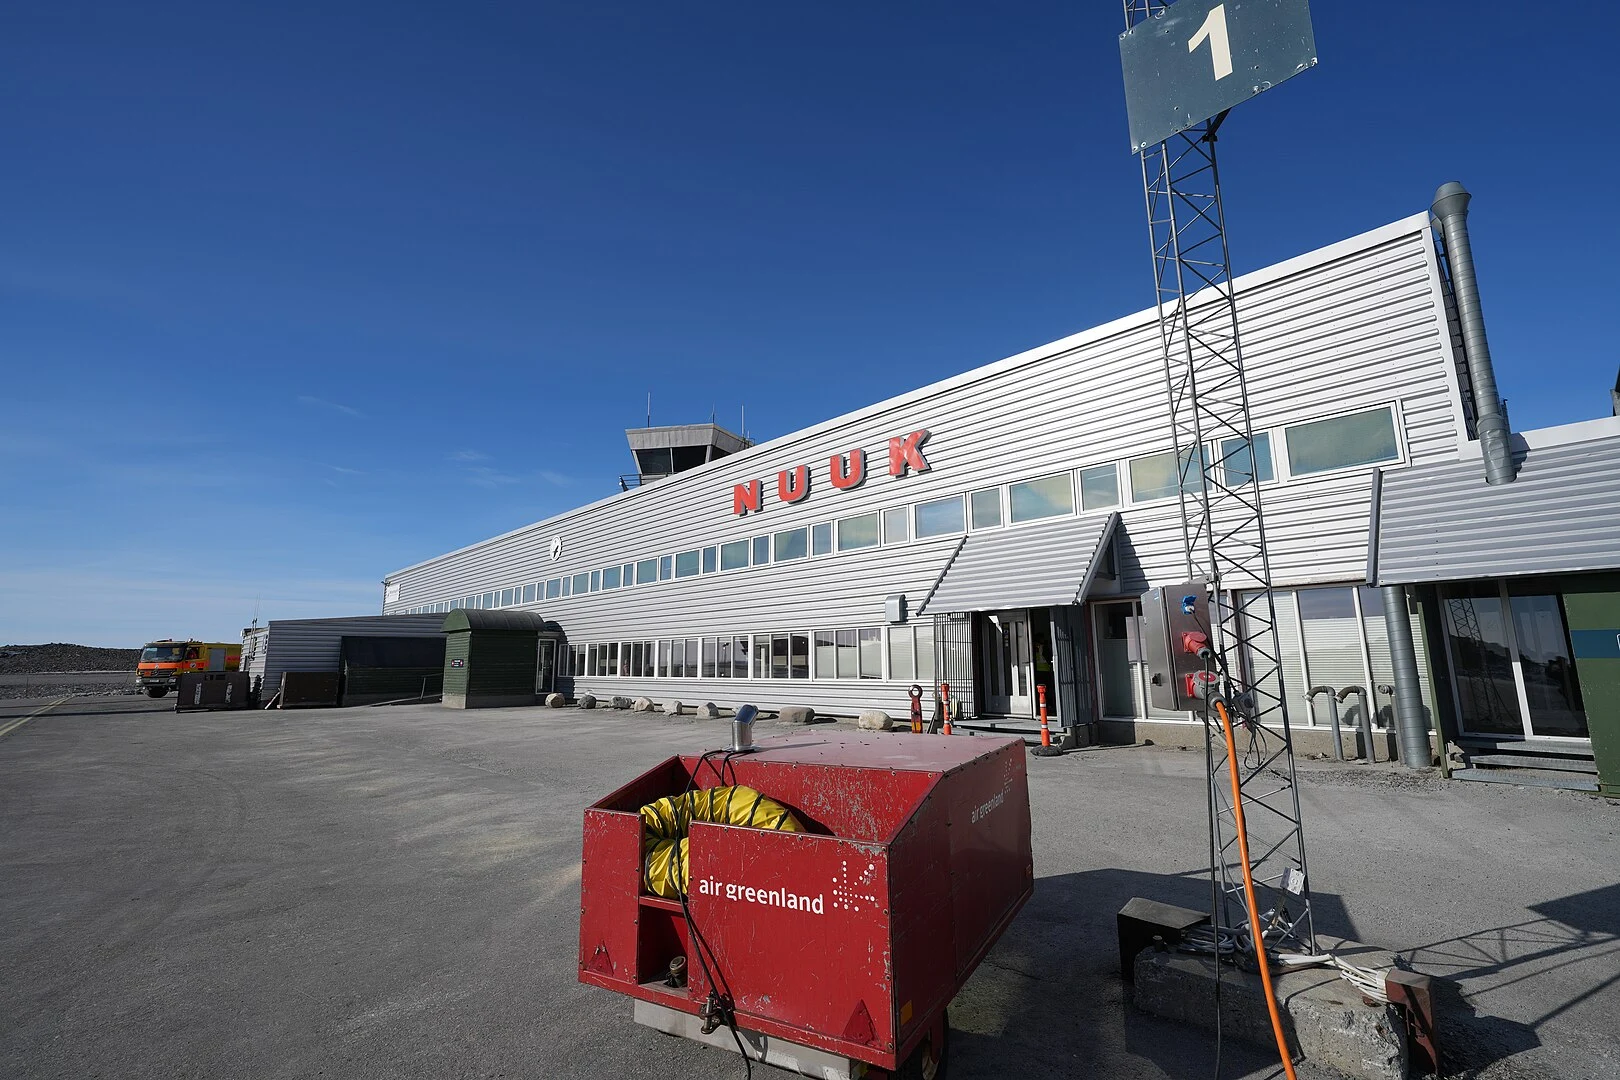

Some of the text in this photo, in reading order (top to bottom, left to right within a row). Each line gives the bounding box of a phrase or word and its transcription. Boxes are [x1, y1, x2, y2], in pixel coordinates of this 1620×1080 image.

[1187, 3, 1233, 81] 1
[733, 428, 930, 515] NUUK
[971, 789, 1004, 824] air greenland
[699, 875, 824, 914] air greenland
